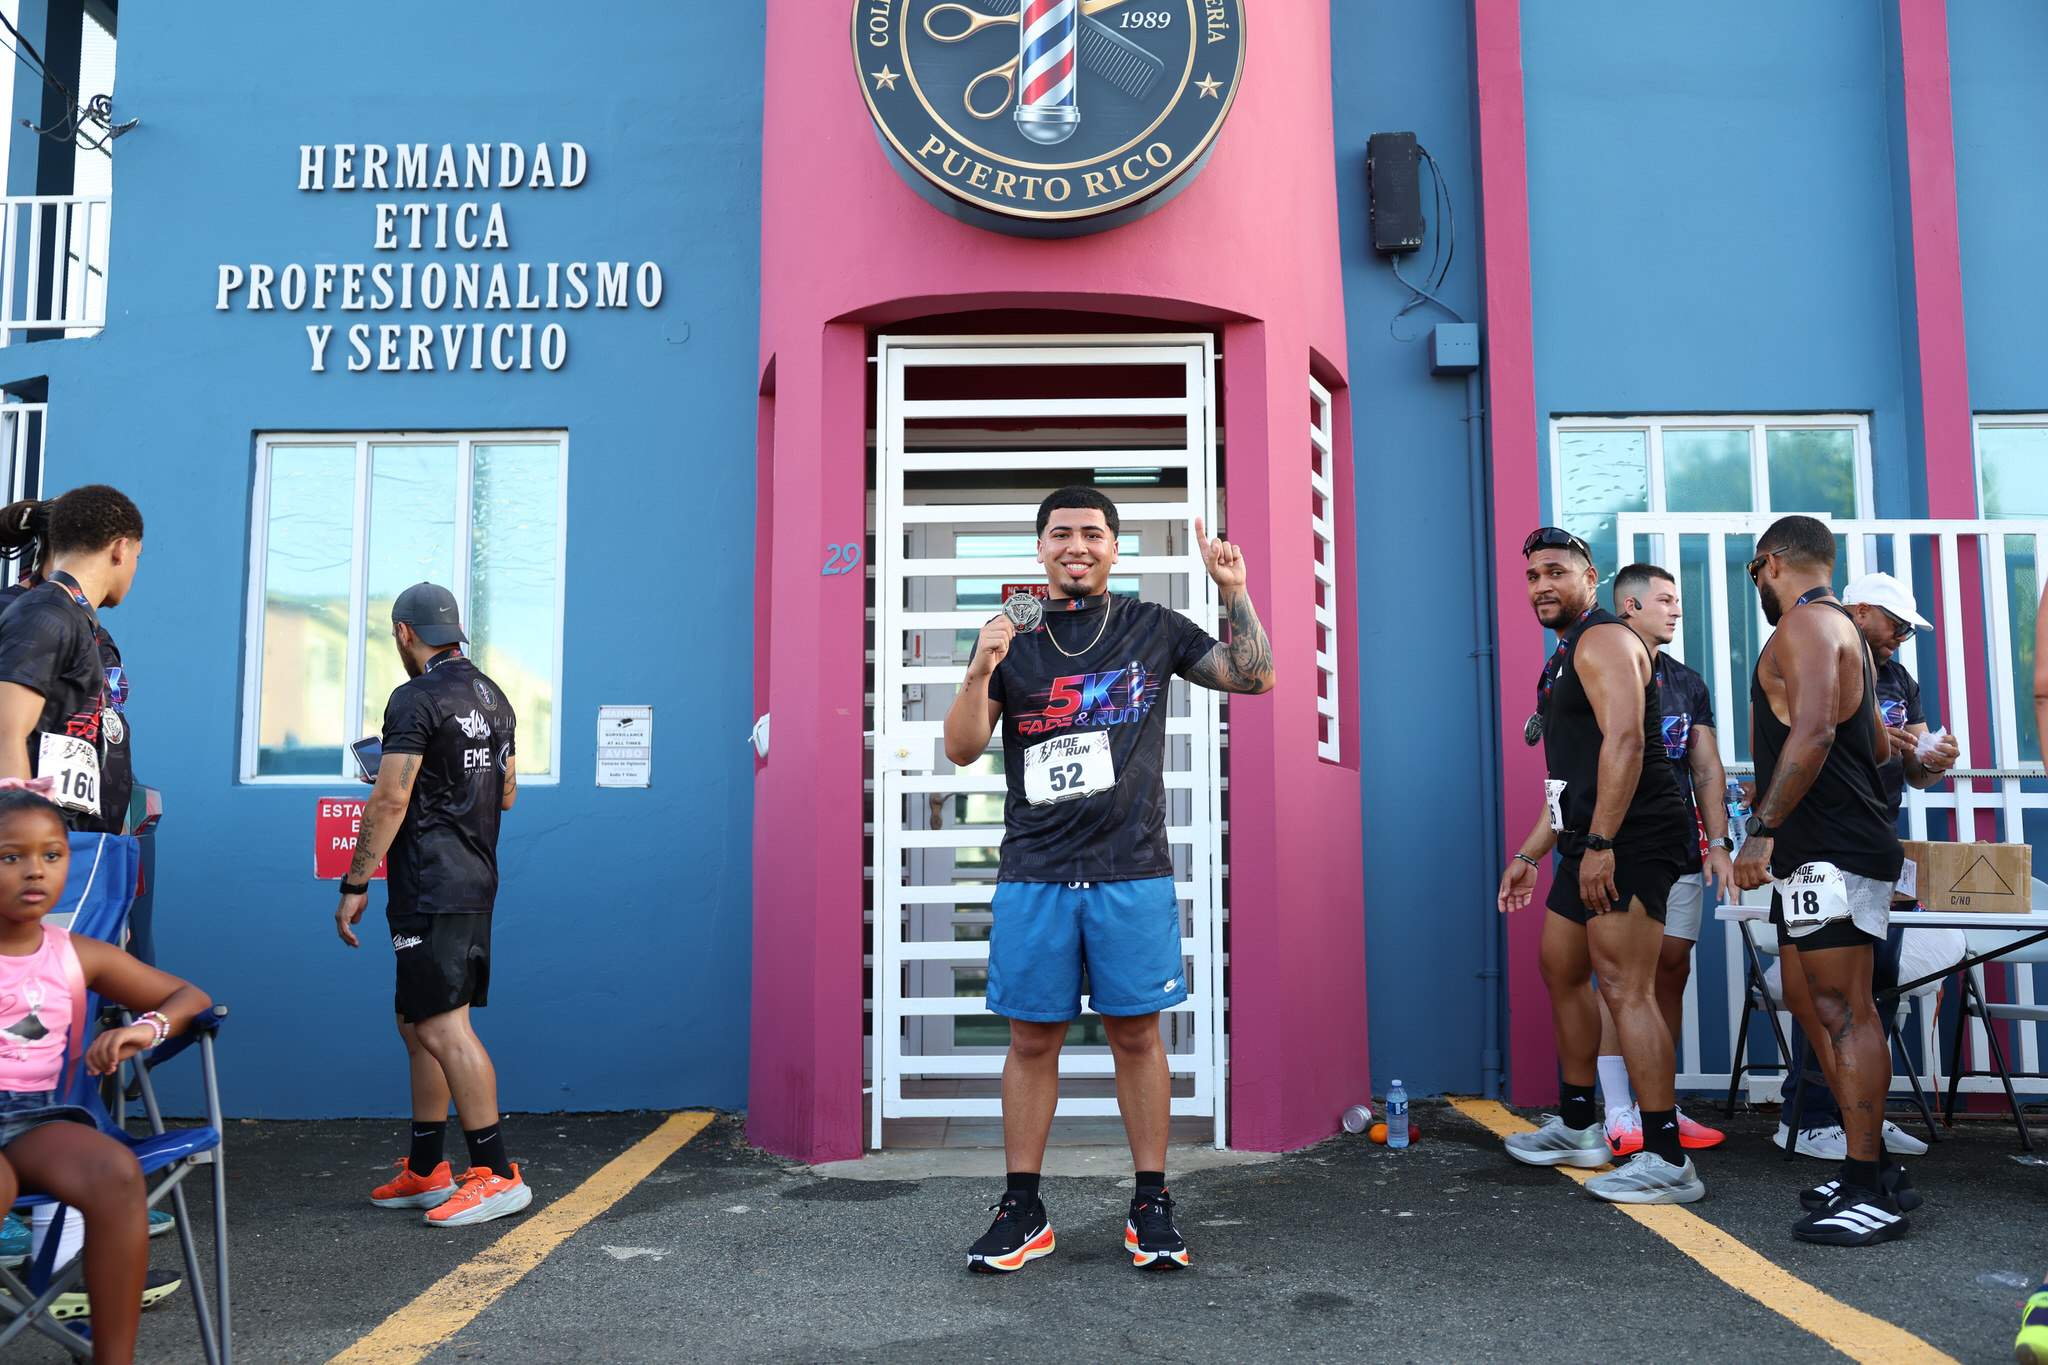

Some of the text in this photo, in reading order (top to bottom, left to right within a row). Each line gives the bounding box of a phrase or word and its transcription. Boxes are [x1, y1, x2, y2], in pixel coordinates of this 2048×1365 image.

[1119, 11, 1171, 29] 1989
[298, 142, 588, 190] HERMANDAD
[917, 134, 1173, 201] PUERTO RICO
[374, 202, 509, 249] ETICA
[215, 261, 663, 311] PROFESIONALISMO
[306, 323, 567, 371] Y SERVICIO
[822, 543, 861, 576] 29
[1042, 669, 1127, 718] 5K
[602, 709, 648, 717] WARNING
[1018, 708, 1139, 735] FADE & RUN
[76, 742, 94, 758] FADE
[605, 749, 642, 757] AVISO
[1050, 737, 1079, 751] FADE
[1065, 745, 1090, 757] RUN
[464, 748, 491, 768] EME
[61, 768, 95, 803] 160
[1049, 762, 1086, 792] 52
[322, 804, 366, 818] ESTA
[1796, 865, 1814, 876] ADE
[1803, 874, 1825, 884] RUN
[1791, 890, 1820, 915] 18
[1950, 896, 1971, 906] C/NO
